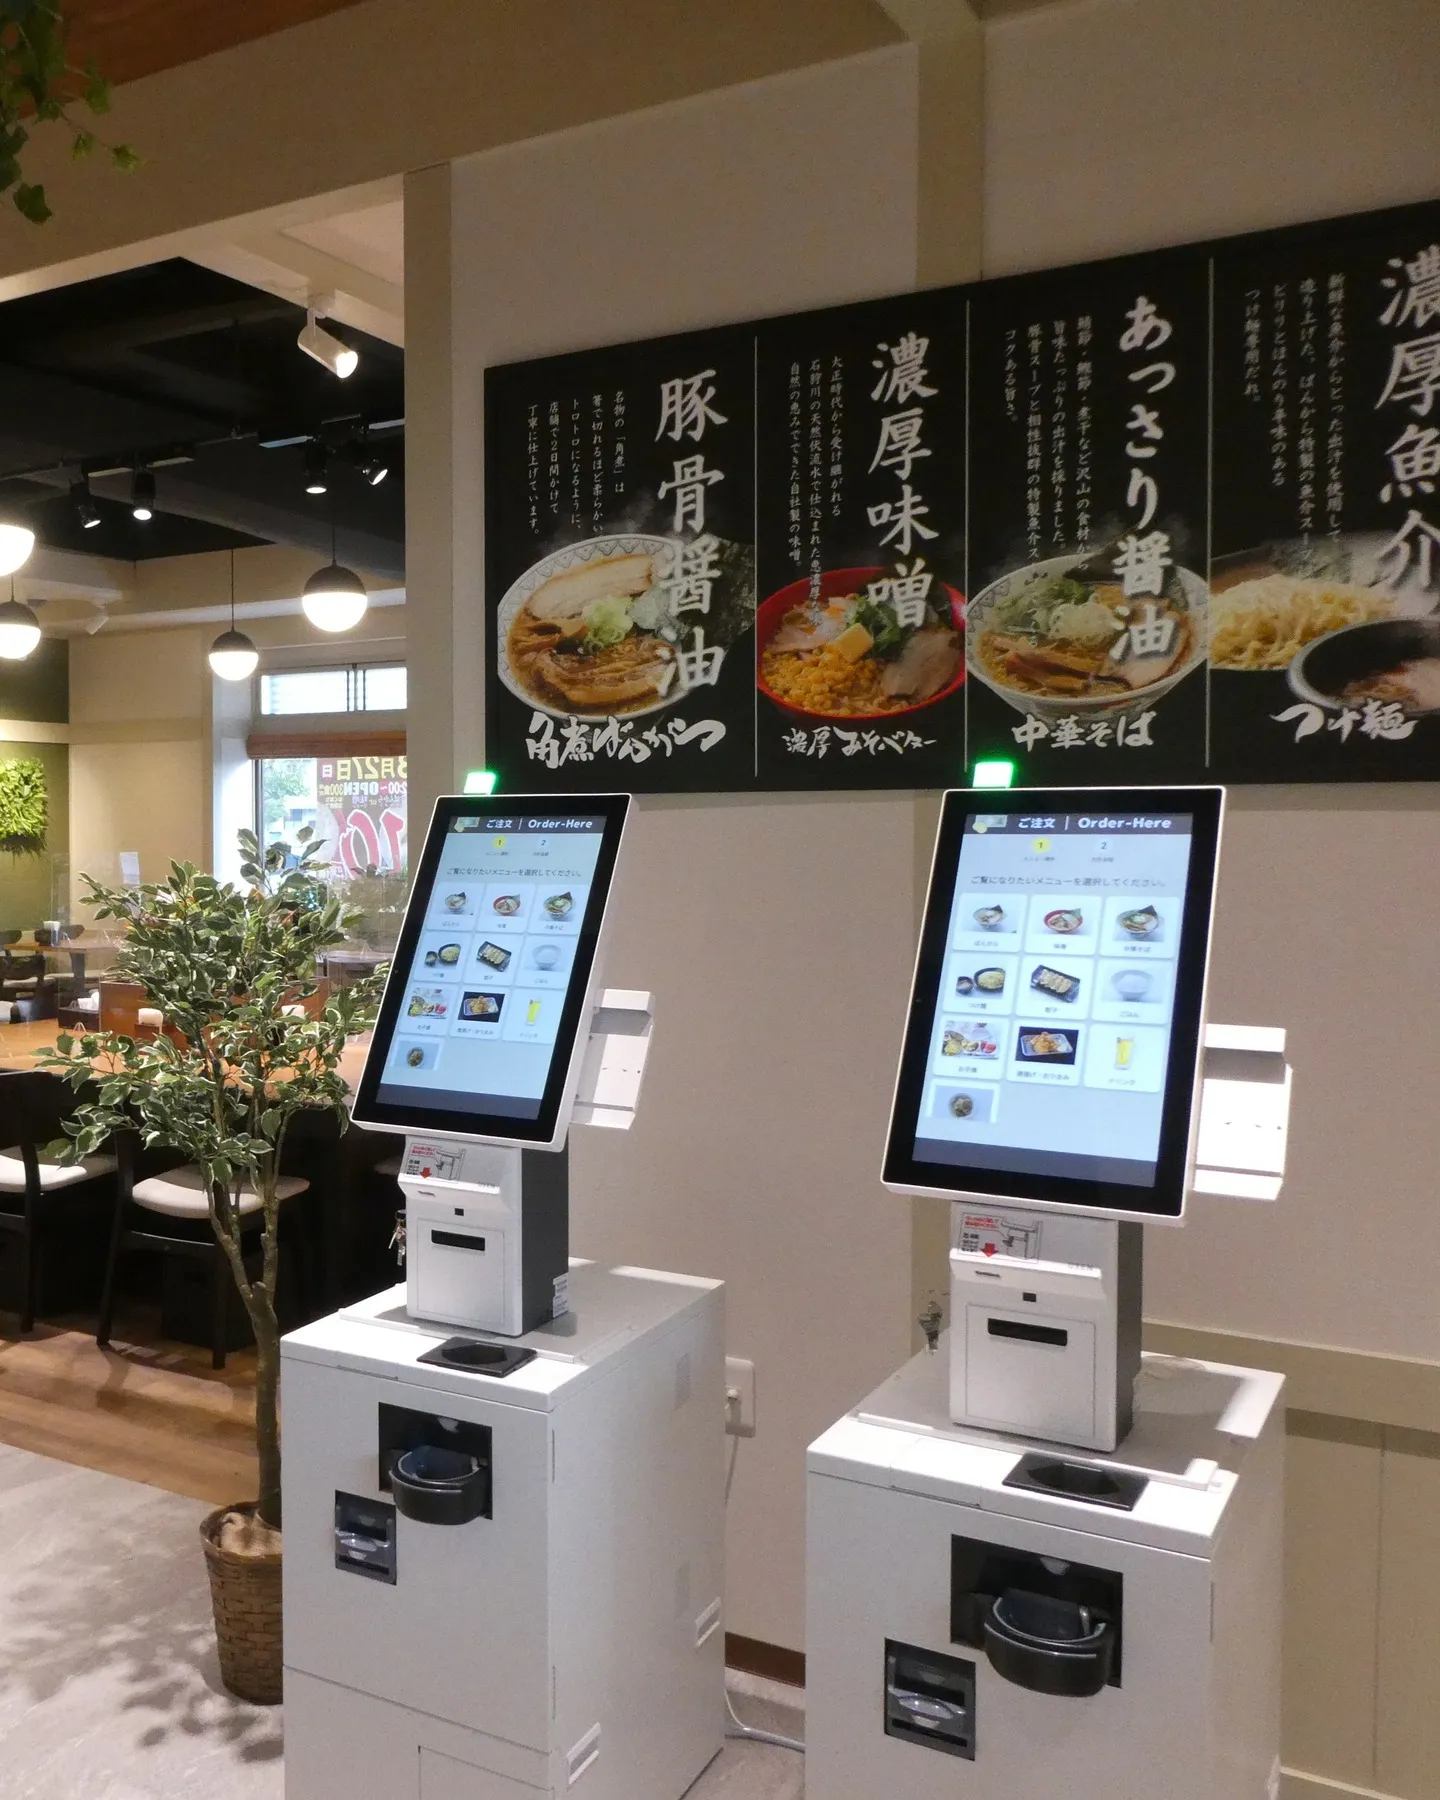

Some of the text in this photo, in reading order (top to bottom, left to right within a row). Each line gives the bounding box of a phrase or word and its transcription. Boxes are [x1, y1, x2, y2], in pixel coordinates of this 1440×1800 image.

[1373, 244, 1440, 590] 濃厚魚介
[527, 404, 540, 534] 丁寧に仕上げています。
[571, 398, 582, 529] トロトロになるように、
[591, 394, 604, 533] 箸で切れるほど柔らかい
[867, 331, 939, 629] 濃厚味噌
[655, 369, 728, 697] 豚骨醤油
[782, 725, 937, 759] 濃厚みそバター
[1011, 710, 1157, 752] 中華そば
[1269, 698, 1419, 744] つけ麺
[486, 819, 593, 830] ご注文 Order-Here
[1018, 817, 1172, 829] ご注文 Order-Here
[447, 867, 581, 877] ご覧になりたいメニューを選択してください。
[970, 875, 1166, 888] ご覧になりたいメニューを選択してください。
